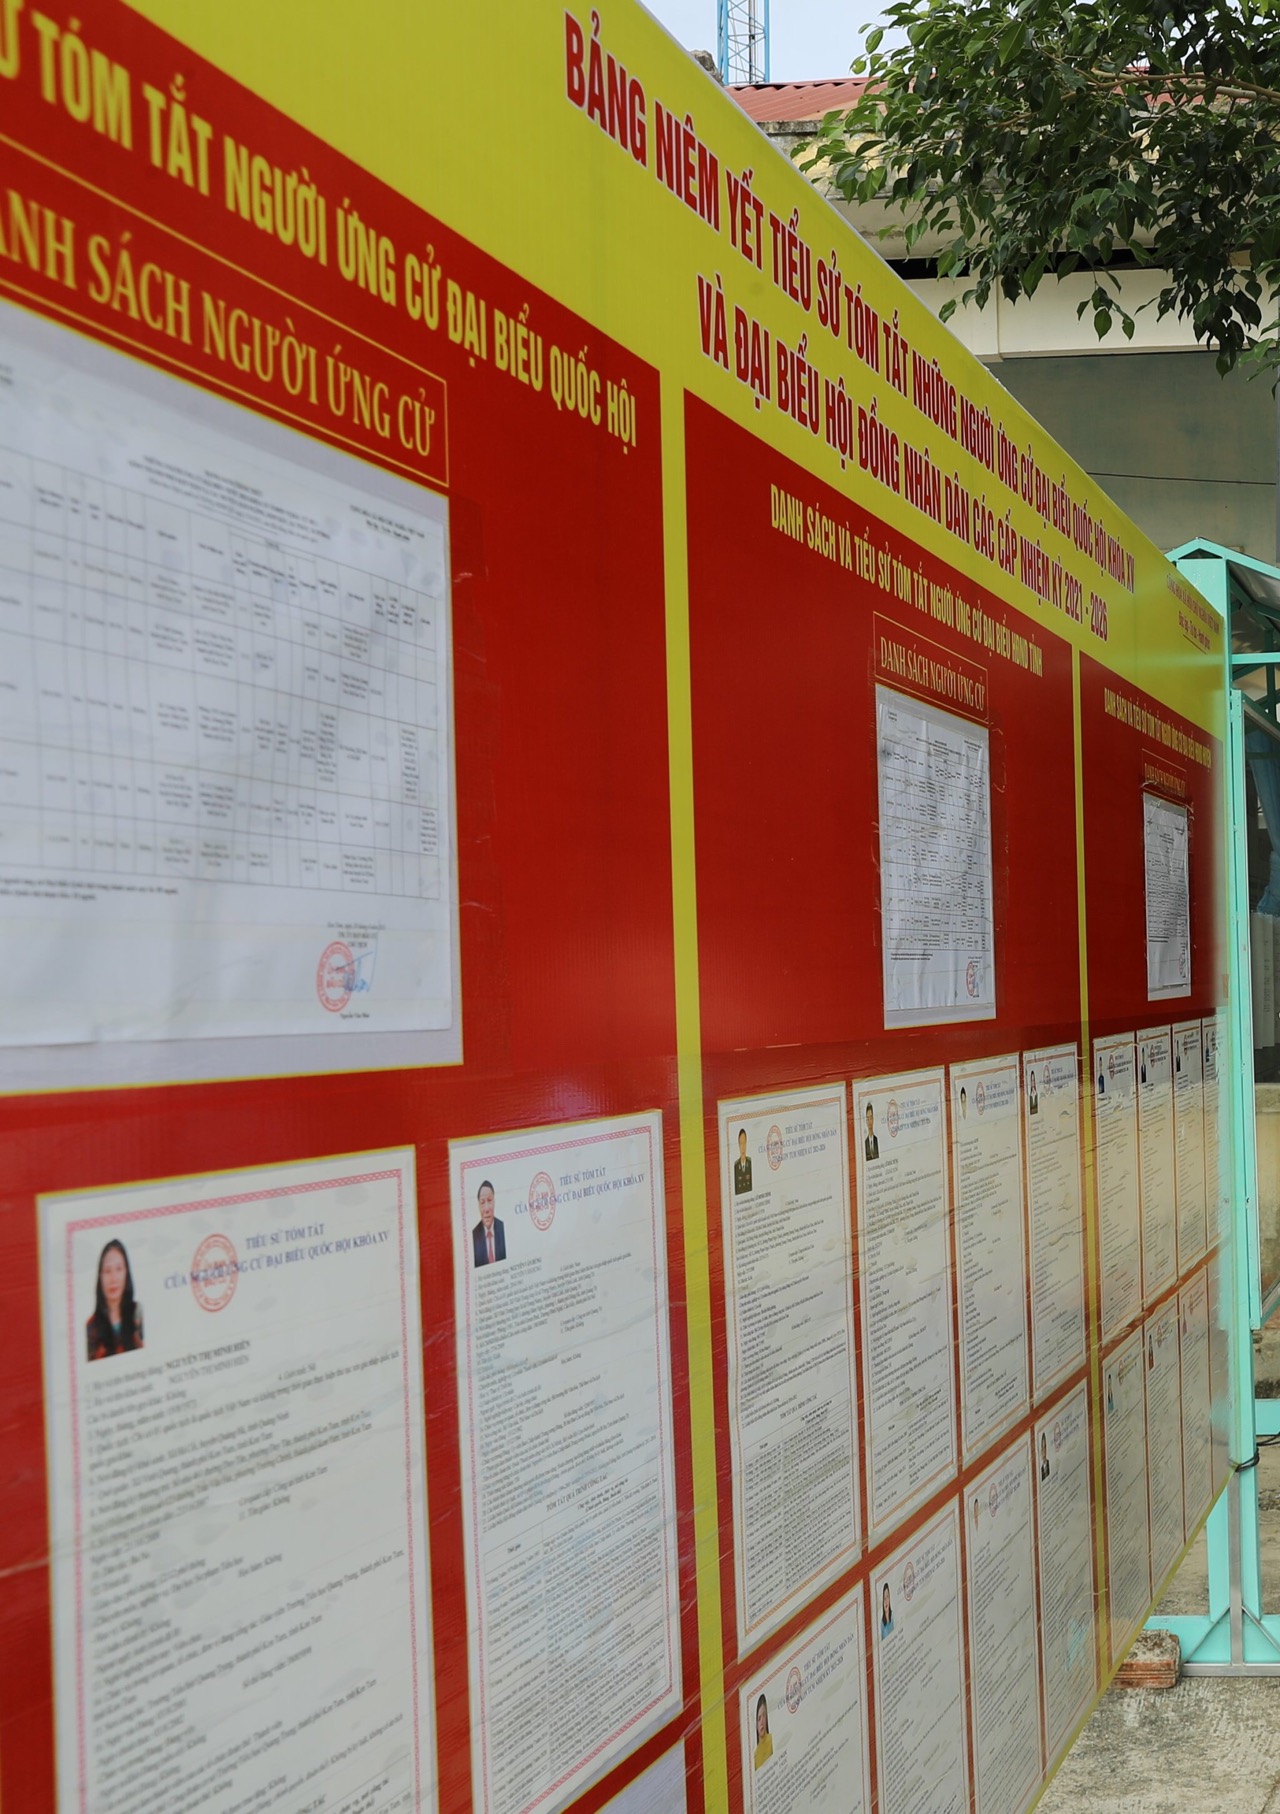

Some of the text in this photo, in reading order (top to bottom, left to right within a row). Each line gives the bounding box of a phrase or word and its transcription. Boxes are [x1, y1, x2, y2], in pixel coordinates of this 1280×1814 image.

[0, 188, 436, 457] NH SÁCH NGƯỜI ỨNG CỬ
[31, 9, 133, 151] TÓM
[142, 73, 213, 197] TẮT
[223, 134, 328, 267] NGƯỜI
[336, 197, 397, 308] ỨNG
[404, 243, 442, 331] CỬ
[446, 277, 487, 368] ĐẠI
[494, 302, 543, 392] BIỂU
[549, 345, 601, 426] QUỐC
[606, 378, 637, 455] HỘI
[564, 7, 1135, 594] BẢNG NIÊM YẾT TIỂU SỬ TÓM TẮT NHỮNG NGƯỜI ỨNG CỬ ĐẠI BIỂU QUỐC HỘI KHÓA XV
[697, 271, 730, 371] VÀ
[734, 304, 771, 412] ĐẠI
[775, 332, 820, 436] BIỂU
[824, 375, 854, 471] HỘI
[857, 396, 900, 495] ĐỒNG
[903, 441, 942, 525] NHÂN
[944, 470, 970, 543] DÂN
[972, 493, 995, 562] CÁC
[997, 508, 1017, 577] CẤP
[1019, 535, 1050, 606] NHIỆM
[1051, 555, 1063, 610] KỲ
[1064, 570, 1083, 625] 2021
[1090, 591, 1108, 643] 2026
[770, 483, 804, 544] DANH
[806, 502, 837, 562] SÁCH
[838, 521, 853, 572] VÀ
[854, 526, 876, 585] TIỂU
[878, 541, 891, 593] SỬ
[892, 554, 912, 605] TÓM
[913, 561, 929, 614] TẮT
[929, 582, 954, 628] NGƯỜI
[955, 590, 971, 637] ỨNG
[972, 599, 982, 644] CỬ
[983, 613, 995, 657] ĐẠI
[880, 636, 906, 677] DANH
[907, 643, 929, 689] SÁCH
[929, 660, 957, 699] NGƯỜI
[957, 666, 974, 707] ỨNG
